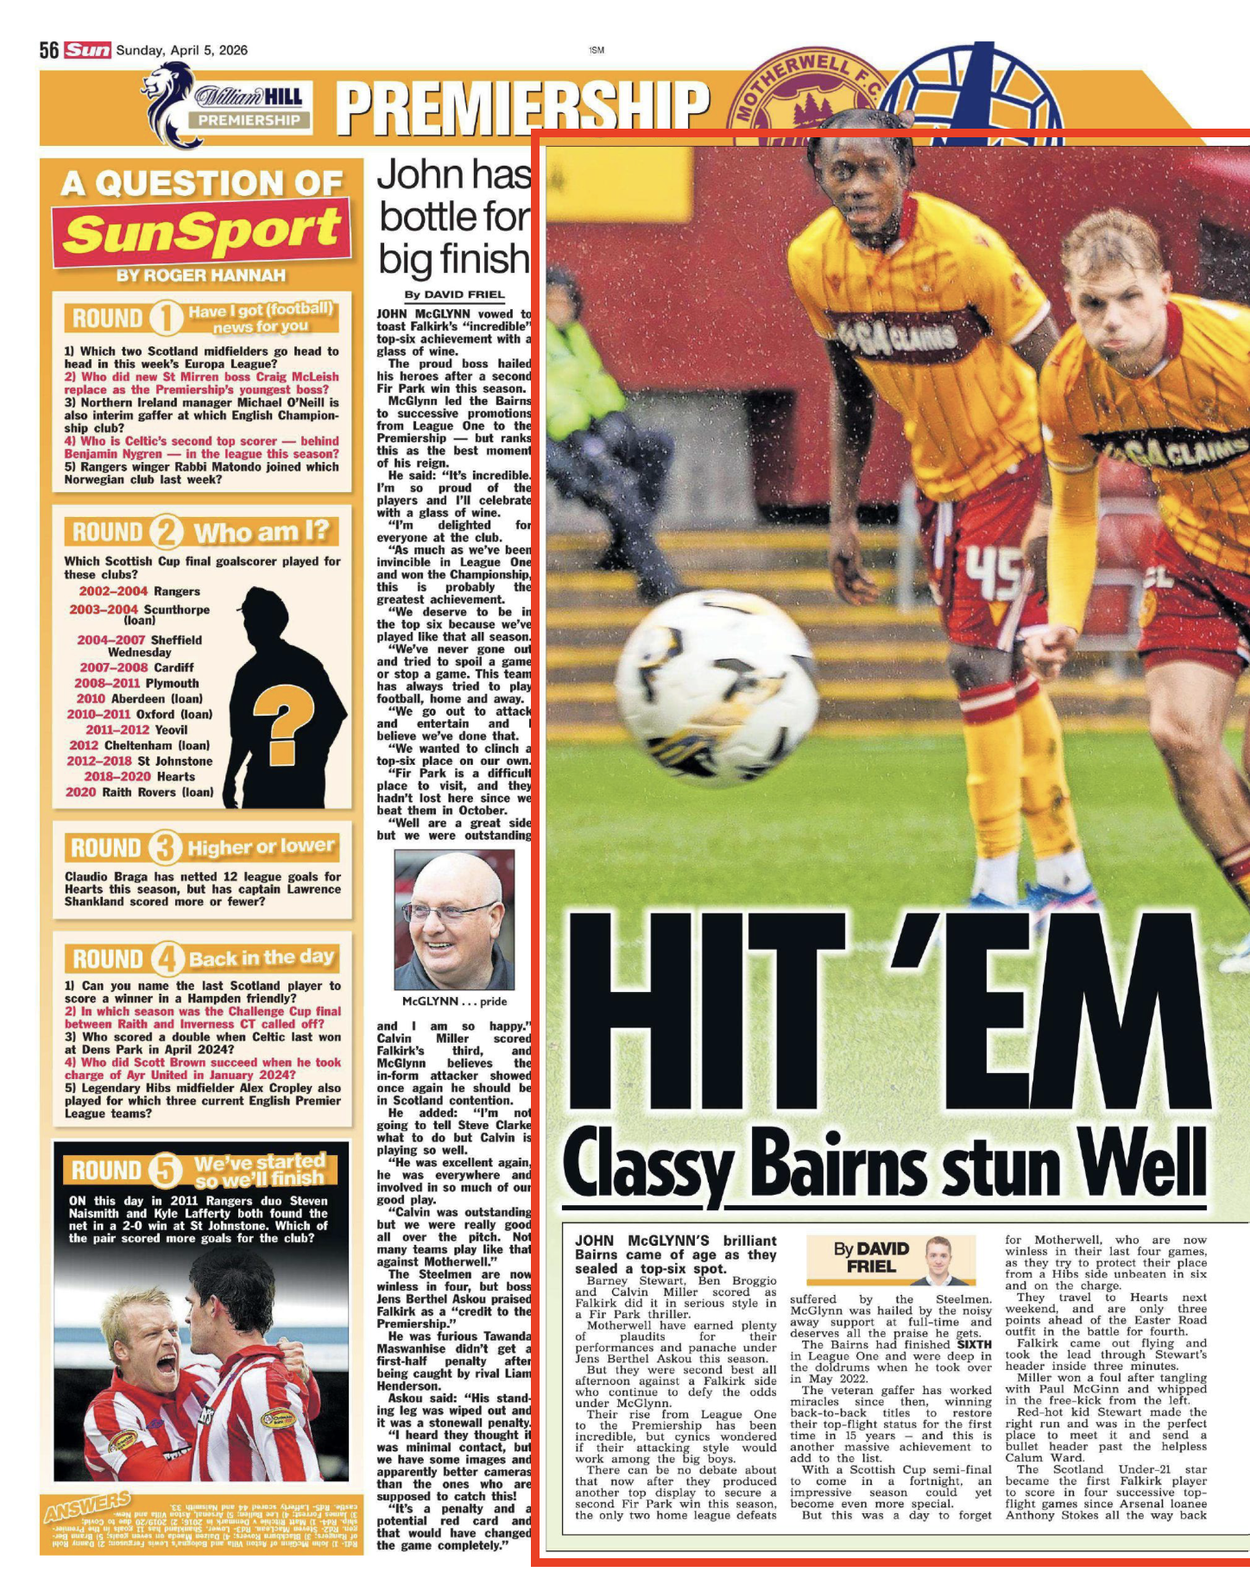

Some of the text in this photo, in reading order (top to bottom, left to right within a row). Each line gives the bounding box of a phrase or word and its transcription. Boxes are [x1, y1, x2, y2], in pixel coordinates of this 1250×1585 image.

[39, 40, 249, 60] 56 Sun Sunday, April 5, 2026
[194, 85, 303, 108] William HILL
[736, 54, 882, 122] MOTHERWELL F.C.
[198, 113, 302, 127] PREMIERSHIP
[336, 80, 711, 137] PREMIERSHIP
[60, 169, 344, 199] A QUESTION OF
[377, 157, 531, 190] John has
[381, 199, 531, 232] bottle for
[62, 207, 343, 260] SunSport
[380, 242, 530, 283] big finish
[116, 268, 286, 283] BY ROGER HANNAH
[404, 290, 506, 301] By DAVID FRIEL
[73, 304, 172, 332] ROUND 1
[188, 301, 334, 320] Have I got (football)
[212, 321, 309, 336] news for you
[376, 345, 459, 358] glass of wine.
[73, 518, 331, 546] ROUND 2 Who am I?
[965, 545, 1023, 601] 45
[154, 585, 201, 599] Rangers
[69, 739, 210, 752] 2012 Cheltenham (loan)
[71, 834, 336, 859] ROUND 3 Higher or lower
[73, 945, 335, 972] ROUND 4 Back in the day
[402, 996, 459, 1006] McGLYNN
[480, 996, 508, 1009] pride
[570, 912, 846, 1110] HIT
[64, 1108, 153, 1121] League teams?
[72, 1157, 176, 1182] ROUND 5
[256, 1151, 327, 1169] started
[562, 1124, 736, 1211] Classy
[751, 1126, 928, 1197] Bairns
[941, 1130, 1060, 1197] stun
[1076, 1126, 1207, 1197] Well
[195, 1176, 218, 1190] so
[270, 1169, 325, 1187] finish
[574, 1234, 614, 1247] JOHN
[723, 1234, 777, 1247] brilliant
[834, 1242, 910, 1258] By DAVID
[847, 1259, 897, 1274] FRIEL
[43, 1490, 132, 1524] ANSWERS
